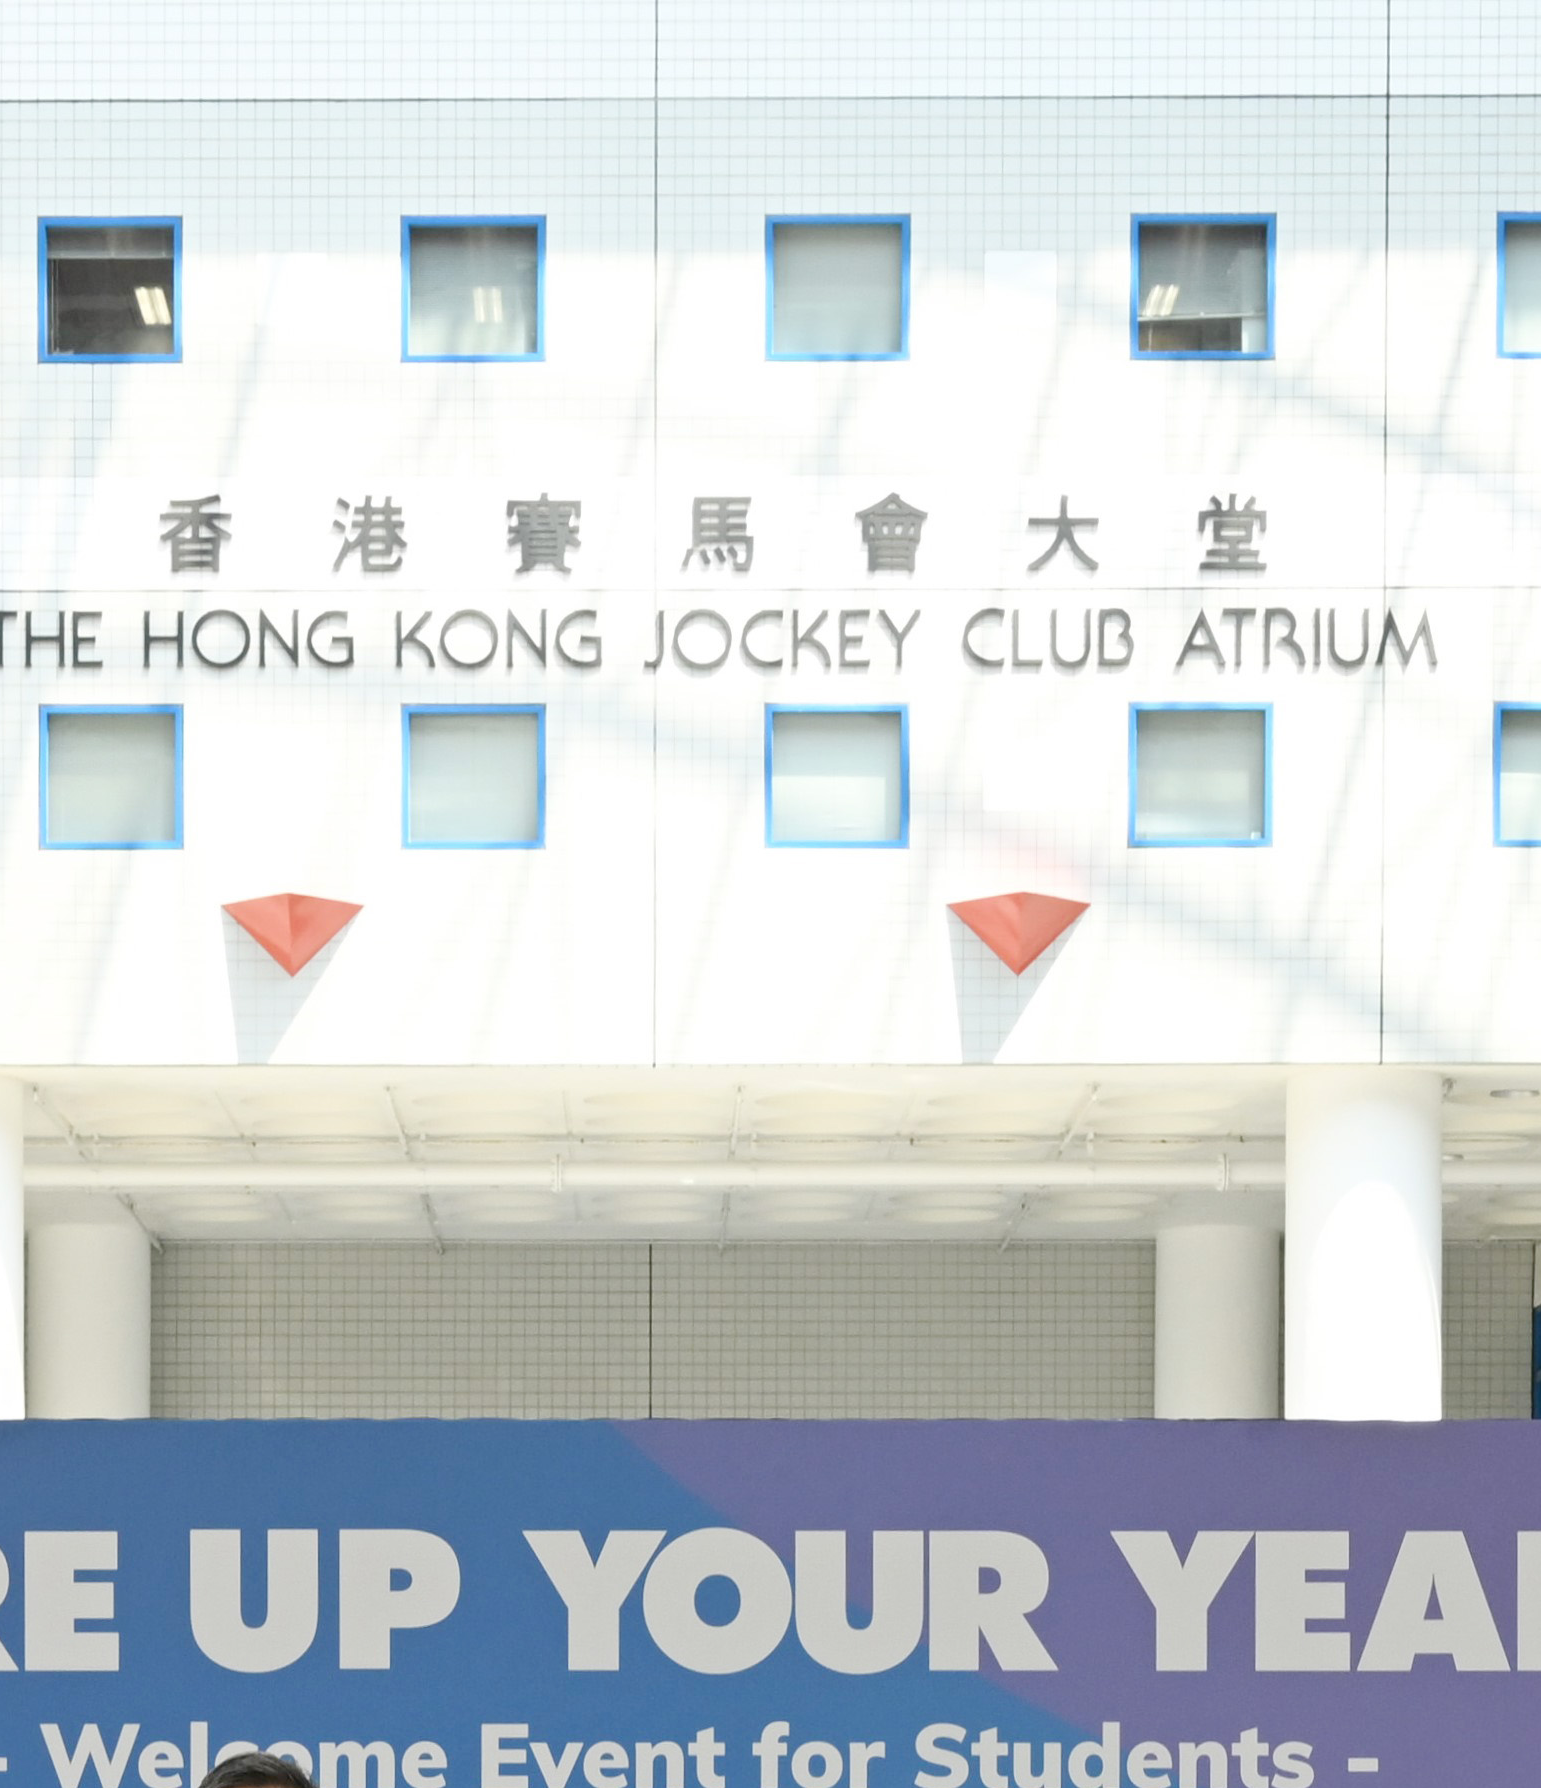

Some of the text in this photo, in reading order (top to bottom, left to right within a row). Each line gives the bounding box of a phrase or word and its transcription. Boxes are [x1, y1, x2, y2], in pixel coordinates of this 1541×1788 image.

[159, 492, 1270, 577] 香港賽馬會大堂
[142, 608, 356, 672] HONG
[393, 608, 604, 672] KONG
[642, 608, 921, 672] JOCKEY
[961, 607, 1135, 671] CLUB
[1175, 607, 1439, 671] ATRIUM
[188, 1528, 462, 1674] UP
[521, 1526, 1059, 1676] YOUR
